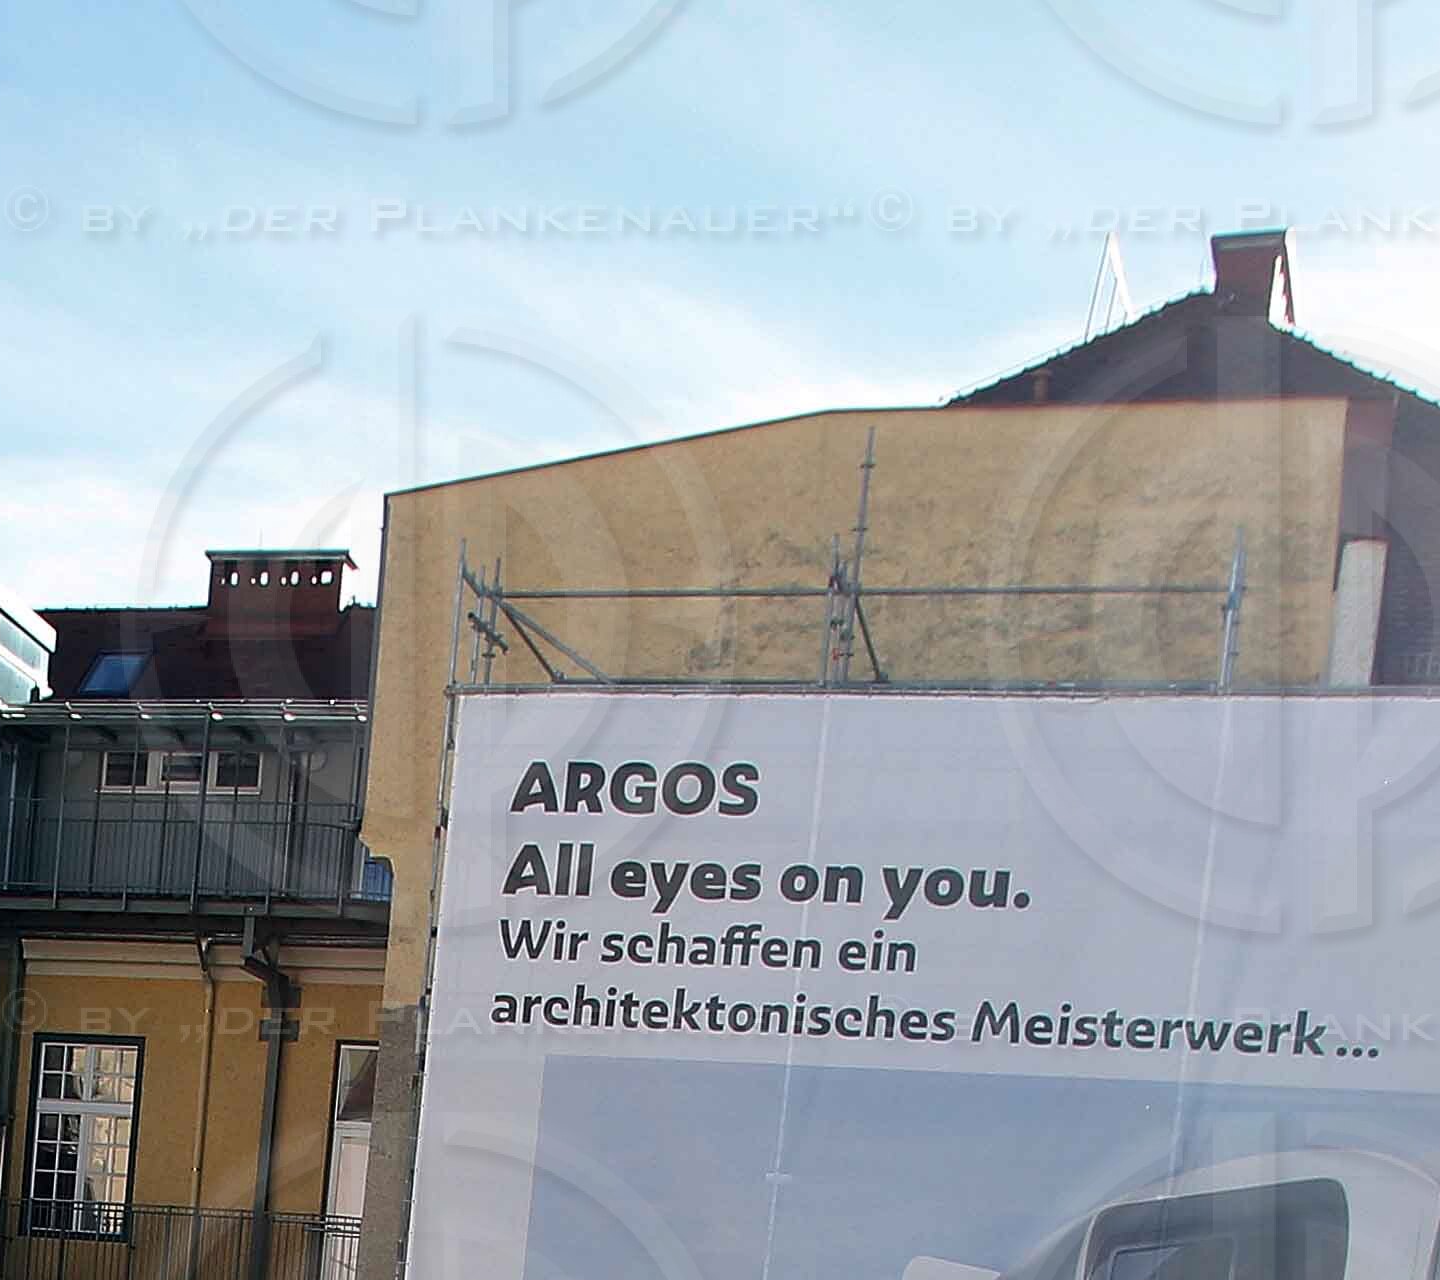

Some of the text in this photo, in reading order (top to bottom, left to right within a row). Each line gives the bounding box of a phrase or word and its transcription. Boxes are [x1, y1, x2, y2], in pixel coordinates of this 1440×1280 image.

[510, 760, 760, 816] ARGOS
[502, 842, 1031, 920] All eyes on you.
[499, 918, 917, 972] Wir schaffen ein
[490, 983, 956, 1042] architektonisches
